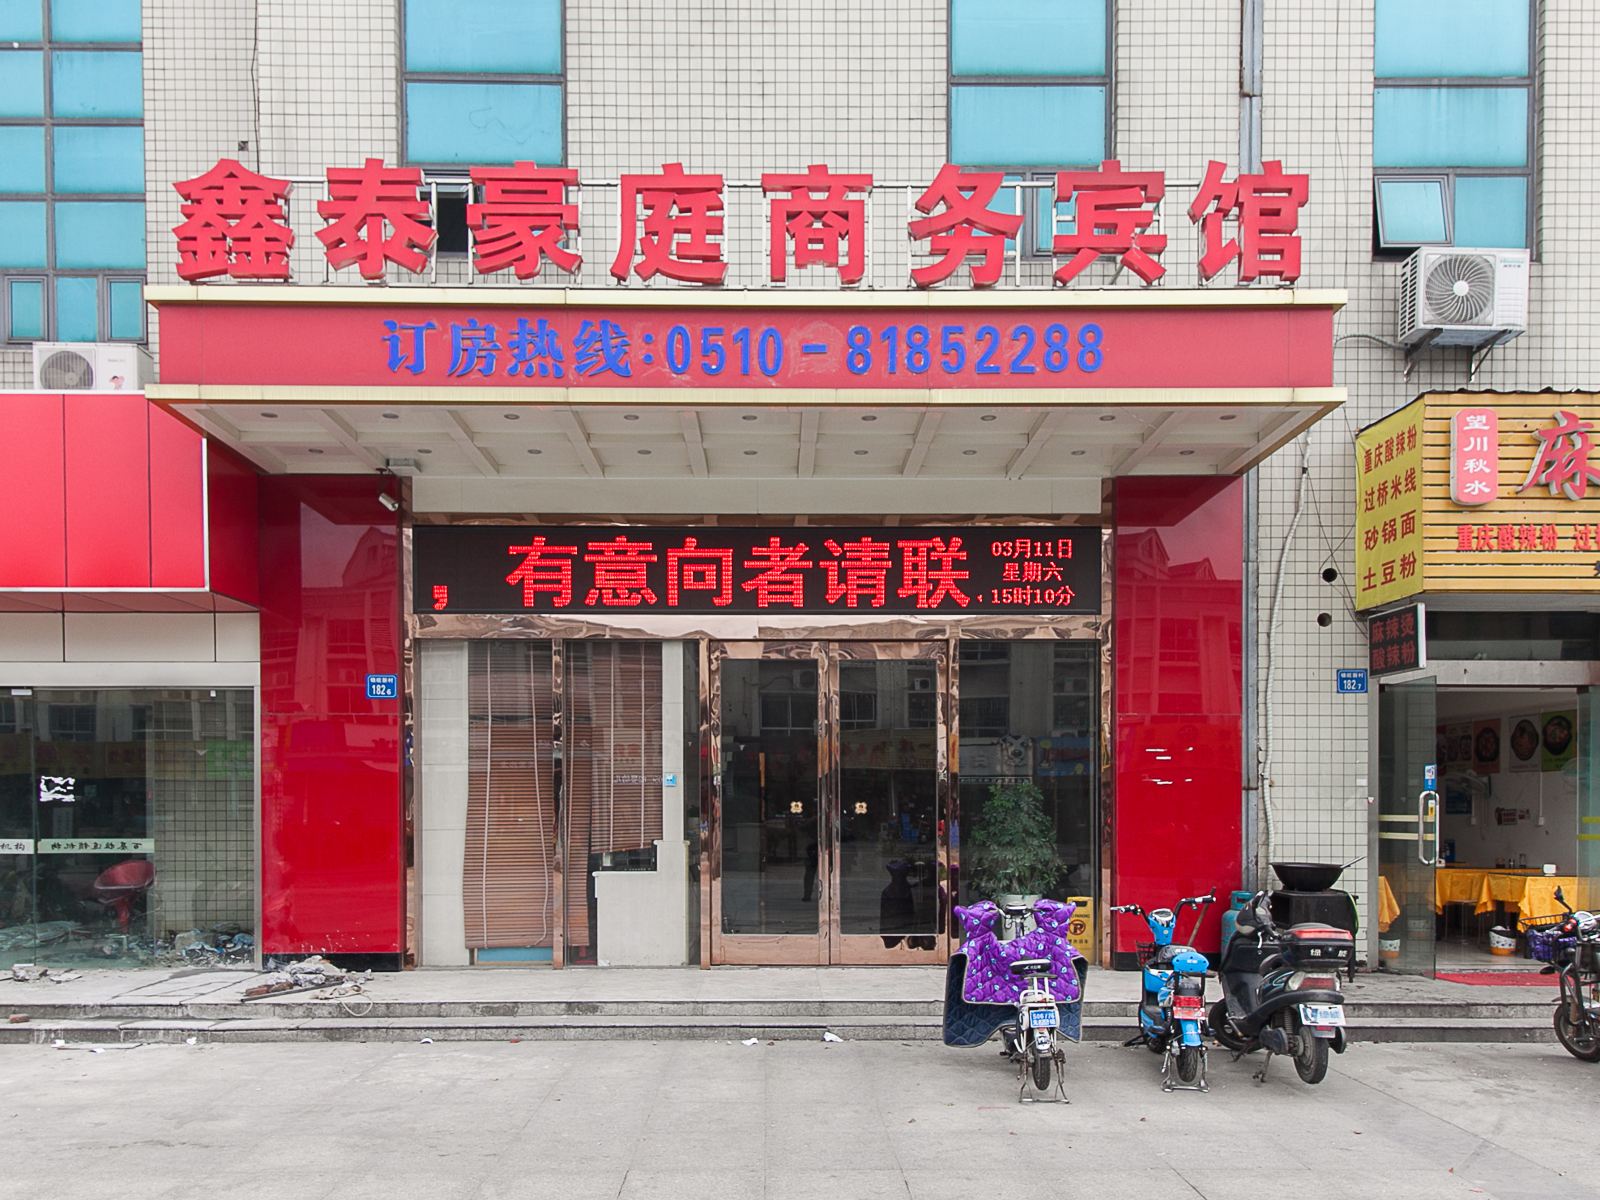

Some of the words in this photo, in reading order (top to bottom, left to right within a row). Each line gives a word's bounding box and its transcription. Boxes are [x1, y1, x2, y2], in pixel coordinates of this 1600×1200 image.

[172, 157, 1310, 286] 鑫泰豪庭商务宾馆
[1363, 423, 1417, 474] 重庆酸辣粉
[1463, 415, 1491, 496] 望川秋水
[1516, 410, 1600, 502] 麻
[1363, 469, 1417, 514] 过桥米线
[991, 538, 1073, 559] 03月11日
[1364, 509, 1416, 549] 砂锅面
[1456, 524, 1558, 551] 重庆酸辣粉
[1002, 561, 1064, 583] 星期六
[1362, 551, 1416, 592] 土豆粉
[991, 585, 1076, 607] 15时10分
[1372, 612, 1415, 644] 麻辣烫
[1372, 640, 1416, 670] 酸辣粉
